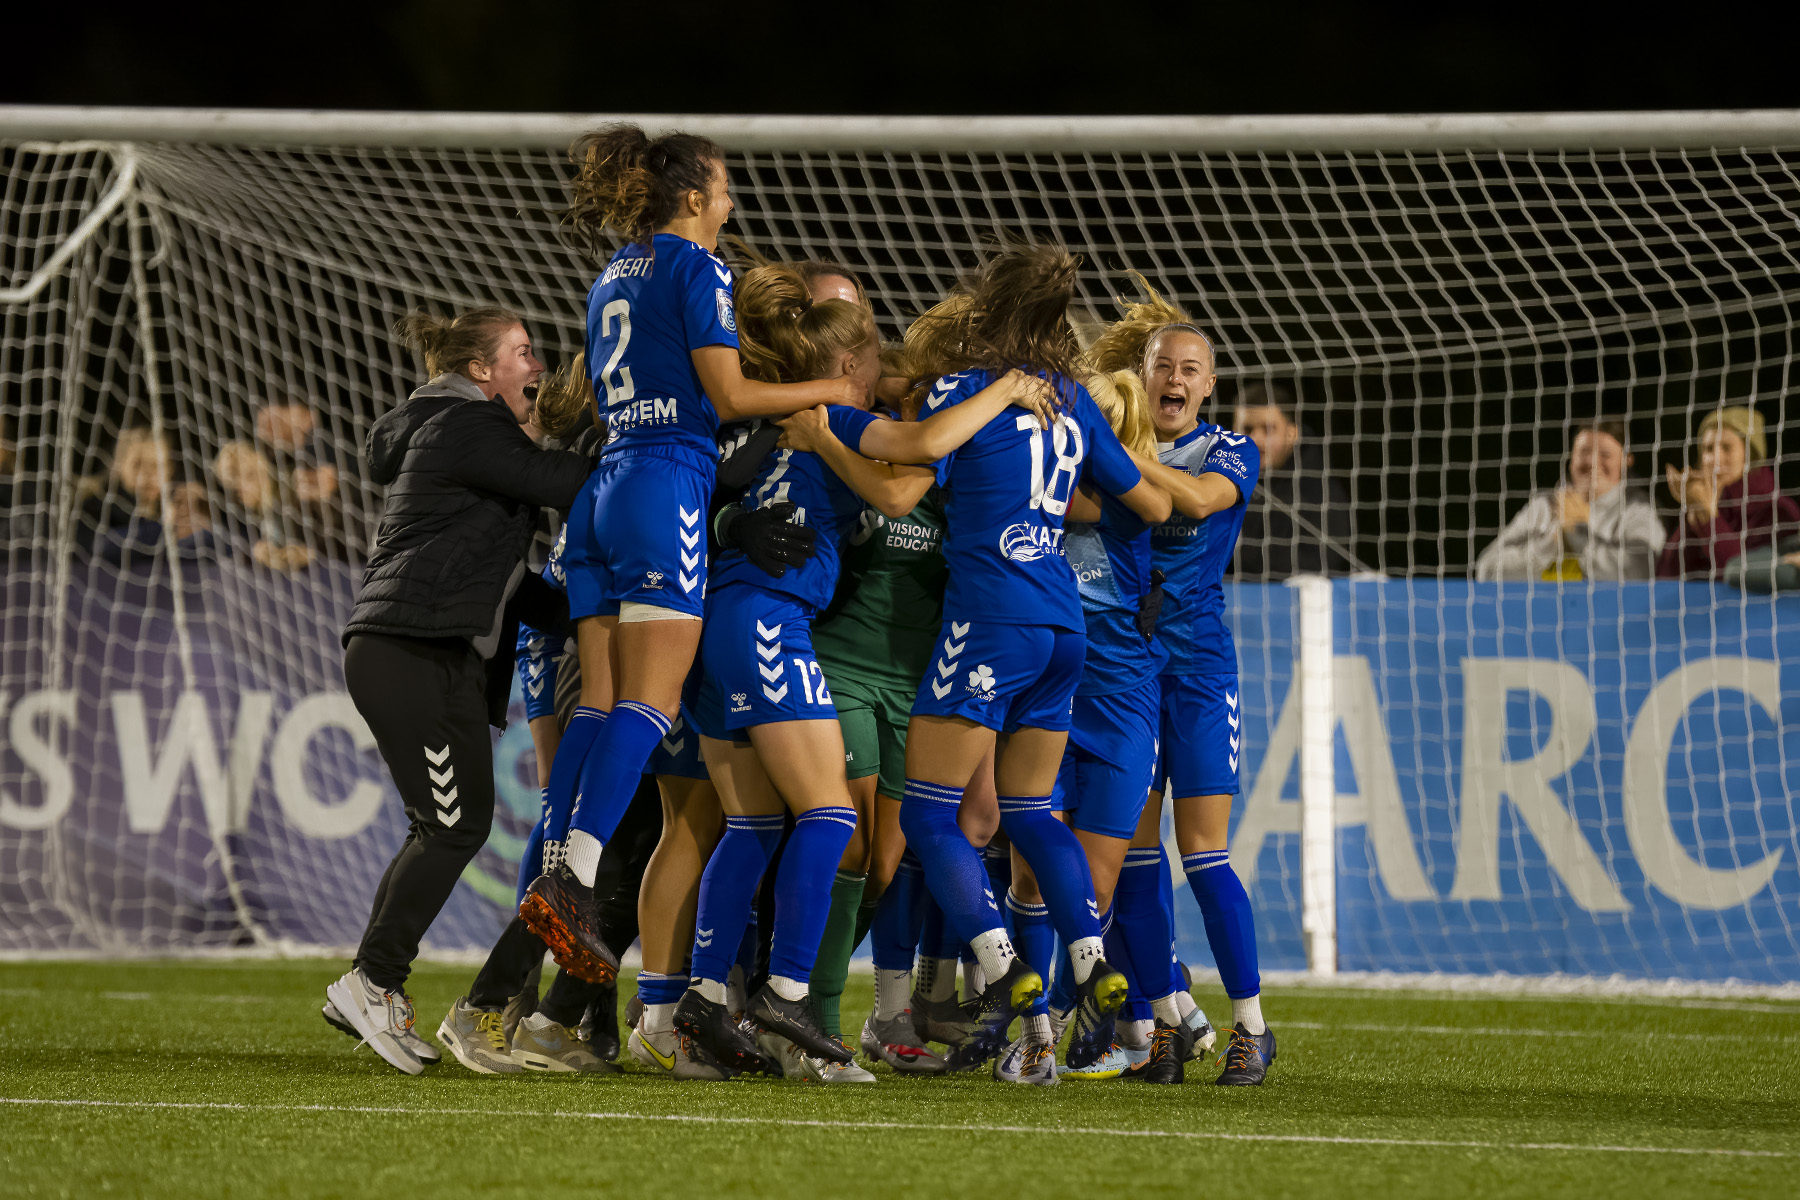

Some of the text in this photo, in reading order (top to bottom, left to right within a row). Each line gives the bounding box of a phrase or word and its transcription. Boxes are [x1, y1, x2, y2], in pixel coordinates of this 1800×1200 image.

[601, 299, 635, 407] 2
[608, 397, 677, 428] KATEM
[1016, 412, 1084, 516] 18
[888, 521, 931, 539] VISION
[793, 658, 833, 705] 12
[0, 690, 384, 838] SWC
[1161, 655, 1785, 911] ARC
